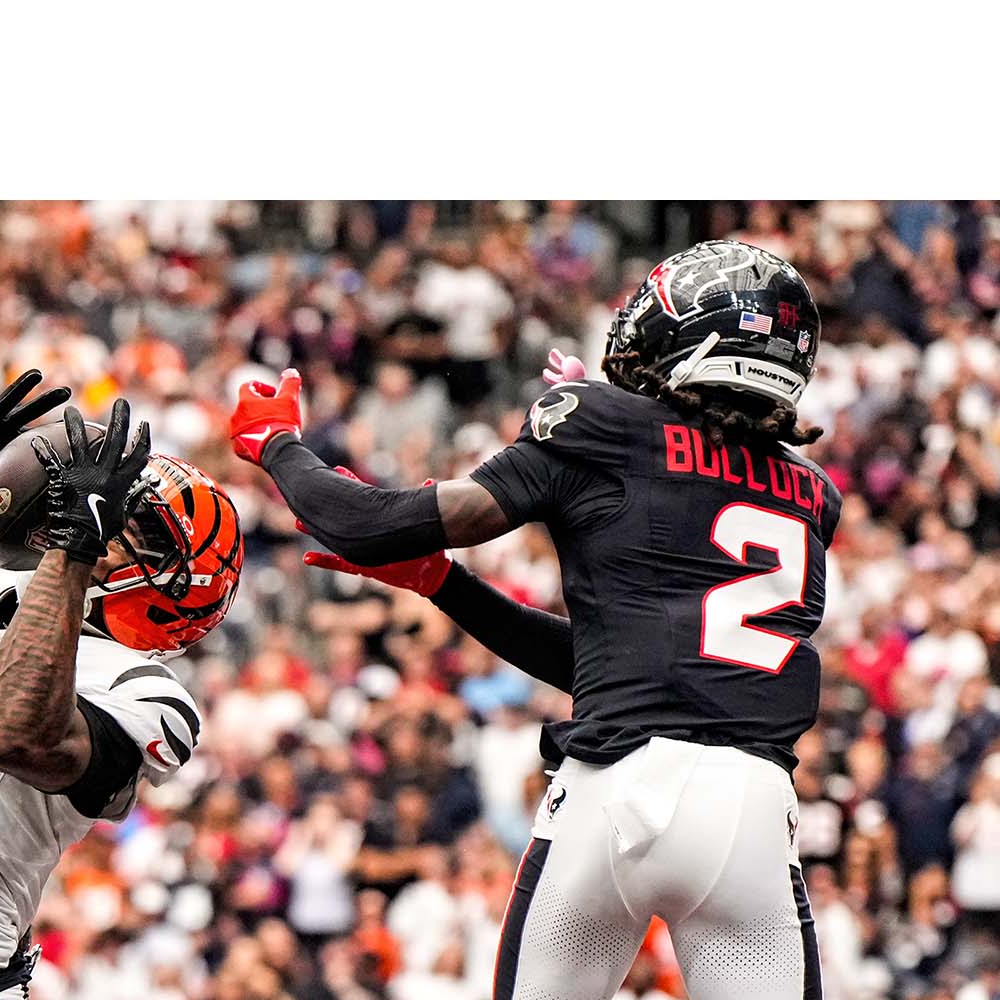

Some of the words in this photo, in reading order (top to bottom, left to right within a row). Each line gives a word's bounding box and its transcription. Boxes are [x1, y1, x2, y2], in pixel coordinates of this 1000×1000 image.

[748, 366, 796, 388] HOUSTON
[663, 424, 826, 526] BULLOCK
[700, 501, 808, 675] 2
